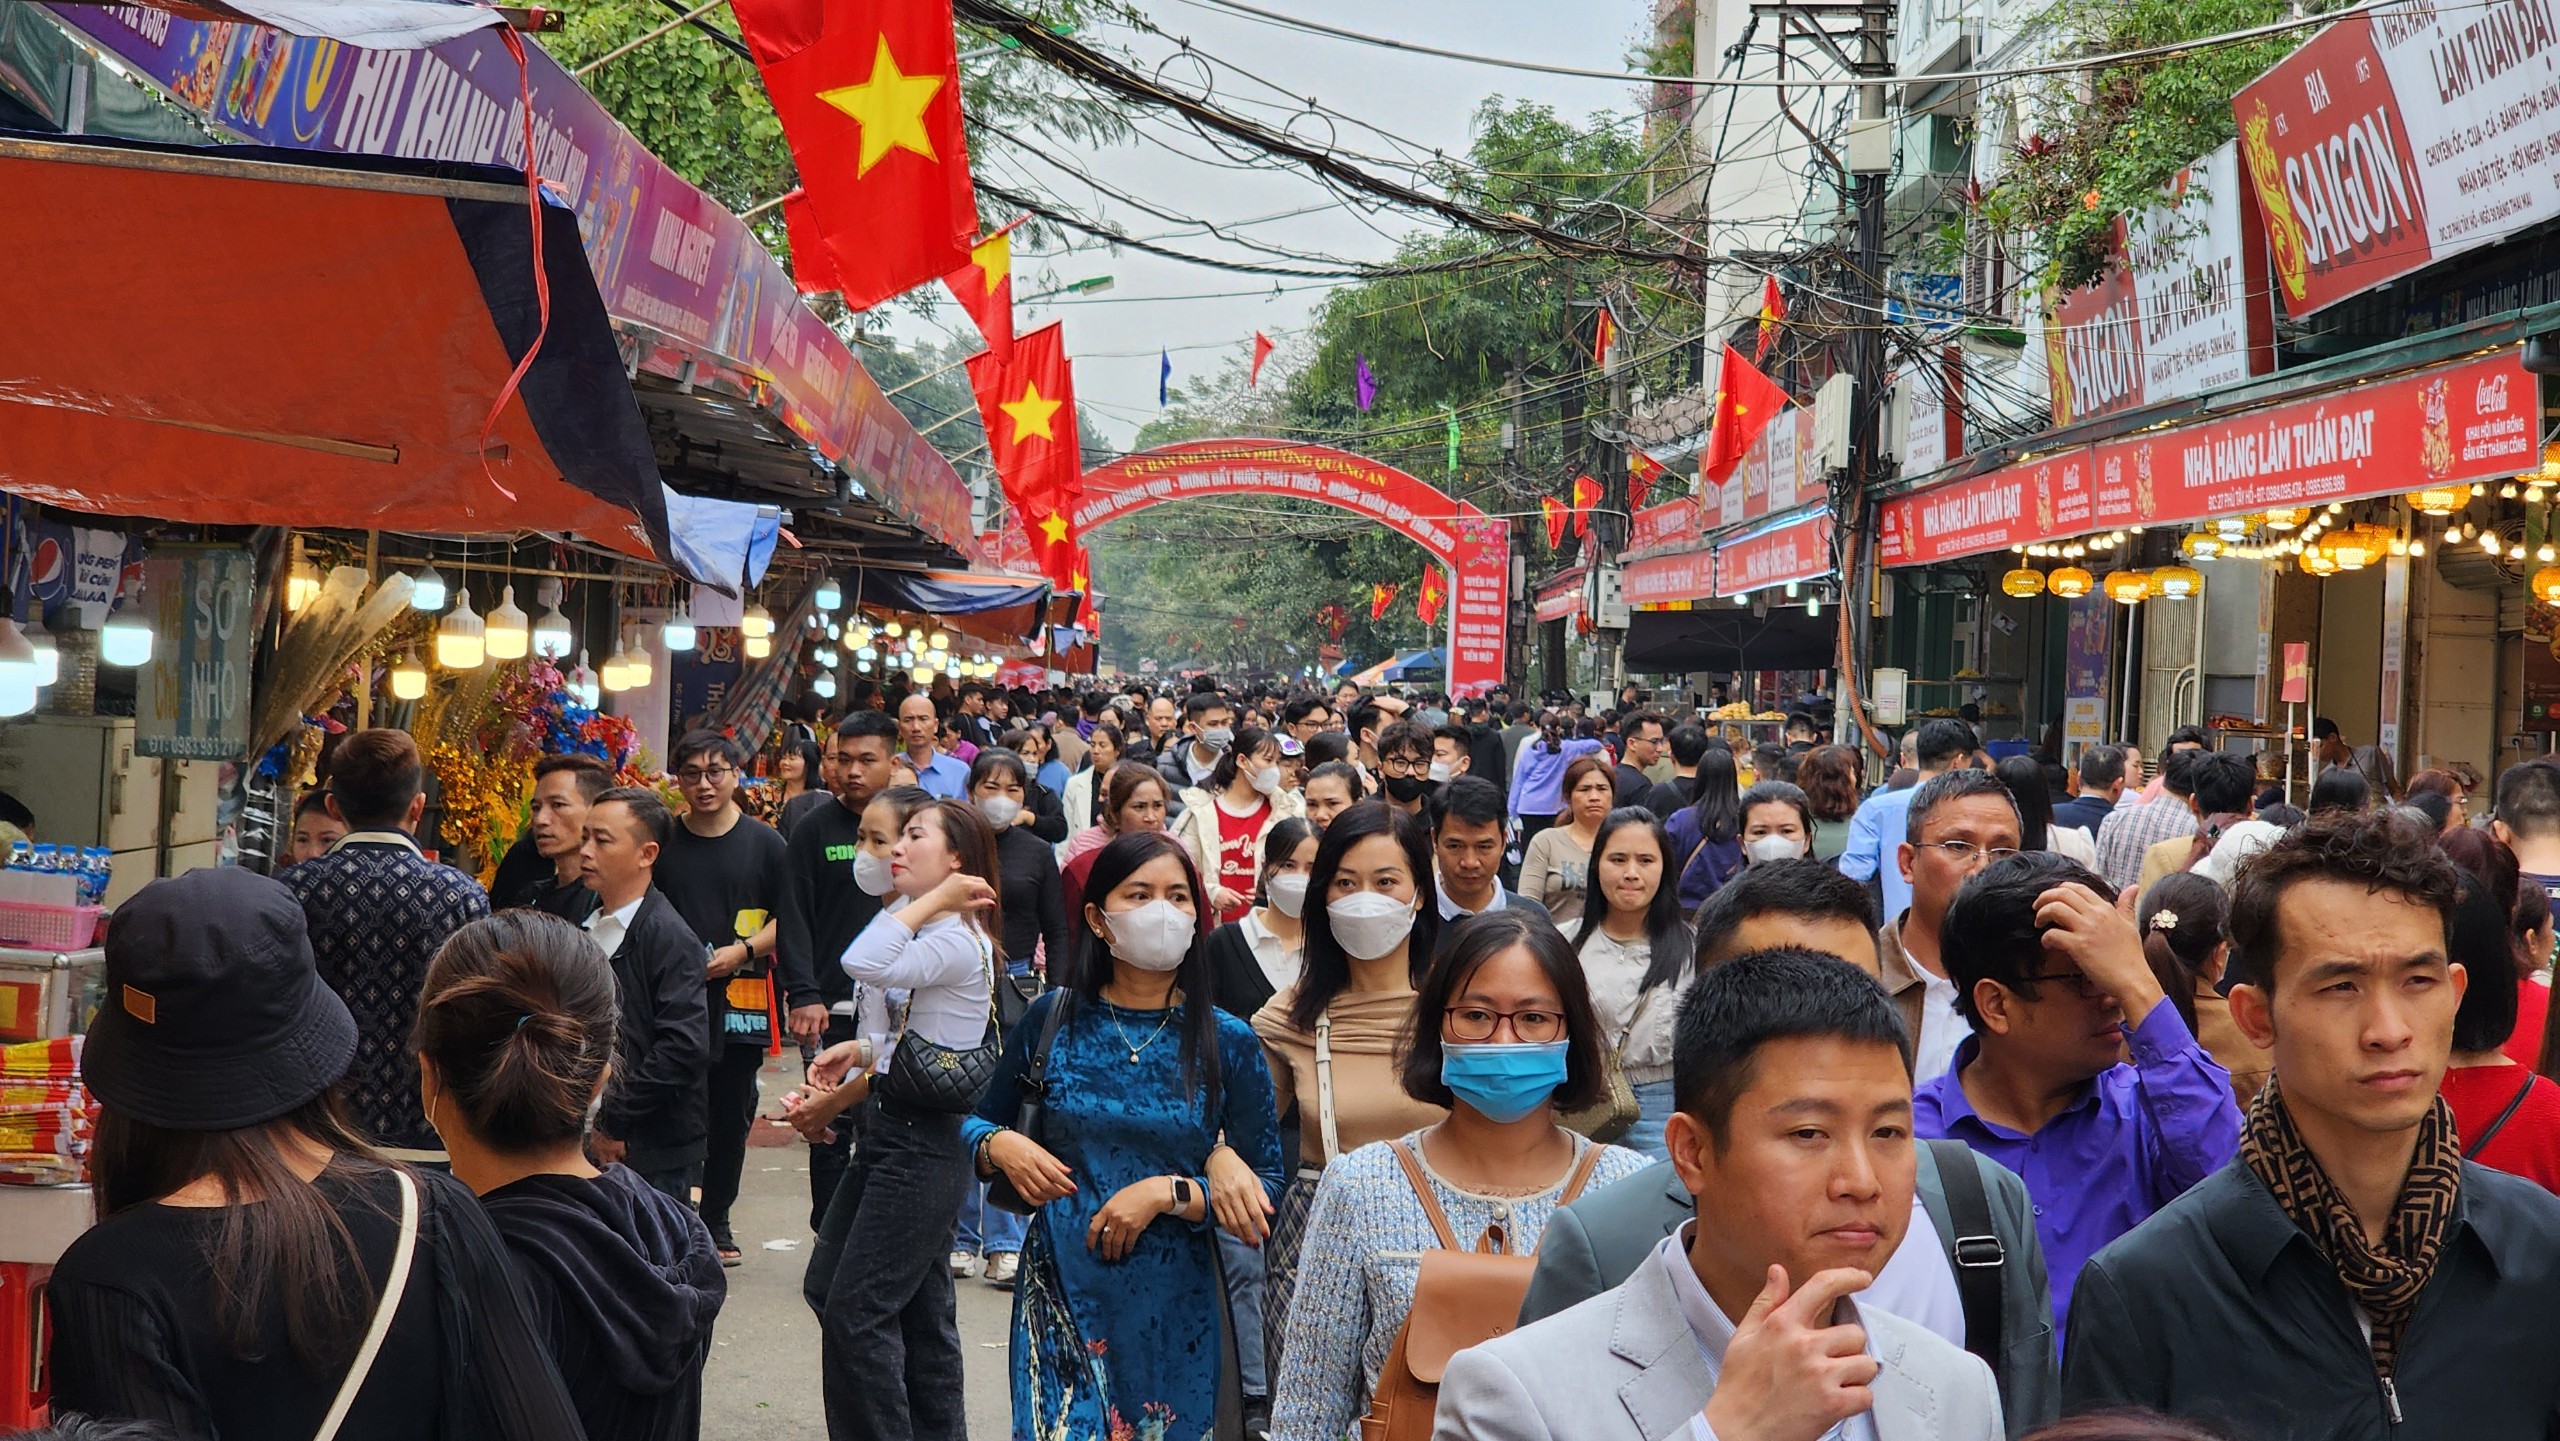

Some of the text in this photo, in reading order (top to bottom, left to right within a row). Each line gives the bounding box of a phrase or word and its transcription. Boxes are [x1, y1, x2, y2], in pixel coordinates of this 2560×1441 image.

[2429, 26, 2474, 105] LÂM
[2514, 0, 2558, 72] ĐẠT
[394, 49, 505, 164] KHÁNH
[2304, 68, 2331, 115] BIA
[2466, 124, 2483, 148] CUA
[2485, 110, 2498, 139] CÁ
[2499, 103, 2522, 132] BÁNH
[2521, 93, 2539, 122] TÔM
[2286, 105, 2412, 265] SAIGON
[2509, 144, 2526, 177] HỘI
[2146, 279, 2172, 346] LÂM
[2065, 296, 2137, 416] SAIGON
[2184, 435, 2213, 488] NHÀ
[2214, 429, 2256, 483] HÀNG
[2258, 420, 2291, 475] LÂM
[2293, 406, 2337, 468] TUẤN
[2340, 409, 2374, 468] ĐẠT
[2466, 426, 2480, 440] KHAI
[2480, 421, 2492, 441] HỘI
[2492, 418, 2505, 435] NĂM
[2488, 439, 2509, 456] THÀNH
[2509, 435, 2527, 453] CÔNG
[1146, 456, 1175, 472] BAN
[1178, 448, 1218, 466] NHÂN
[1366, 471, 1388, 487] AN
[1111, 484, 1148, 510] QUANG
[1146, 477, 1173, 497] VINH
[1263, 468, 1291, 488] PHÁT
[1357, 491, 1389, 515] XUÂN
[1429, 527, 1456, 553] 2024
[1923, 498, 1941, 538] NHÀ
[1940, 495, 1961, 534] HÀNG
[1962, 489, 1979, 529] LÂM
[1980, 478, 2003, 525] TUẤN
[2004, 483, 2022, 525] ĐẠT
[191, 660, 236, 720] NHO
[171, 736, 197, 755] 0983
[200, 737, 219, 756] 983
